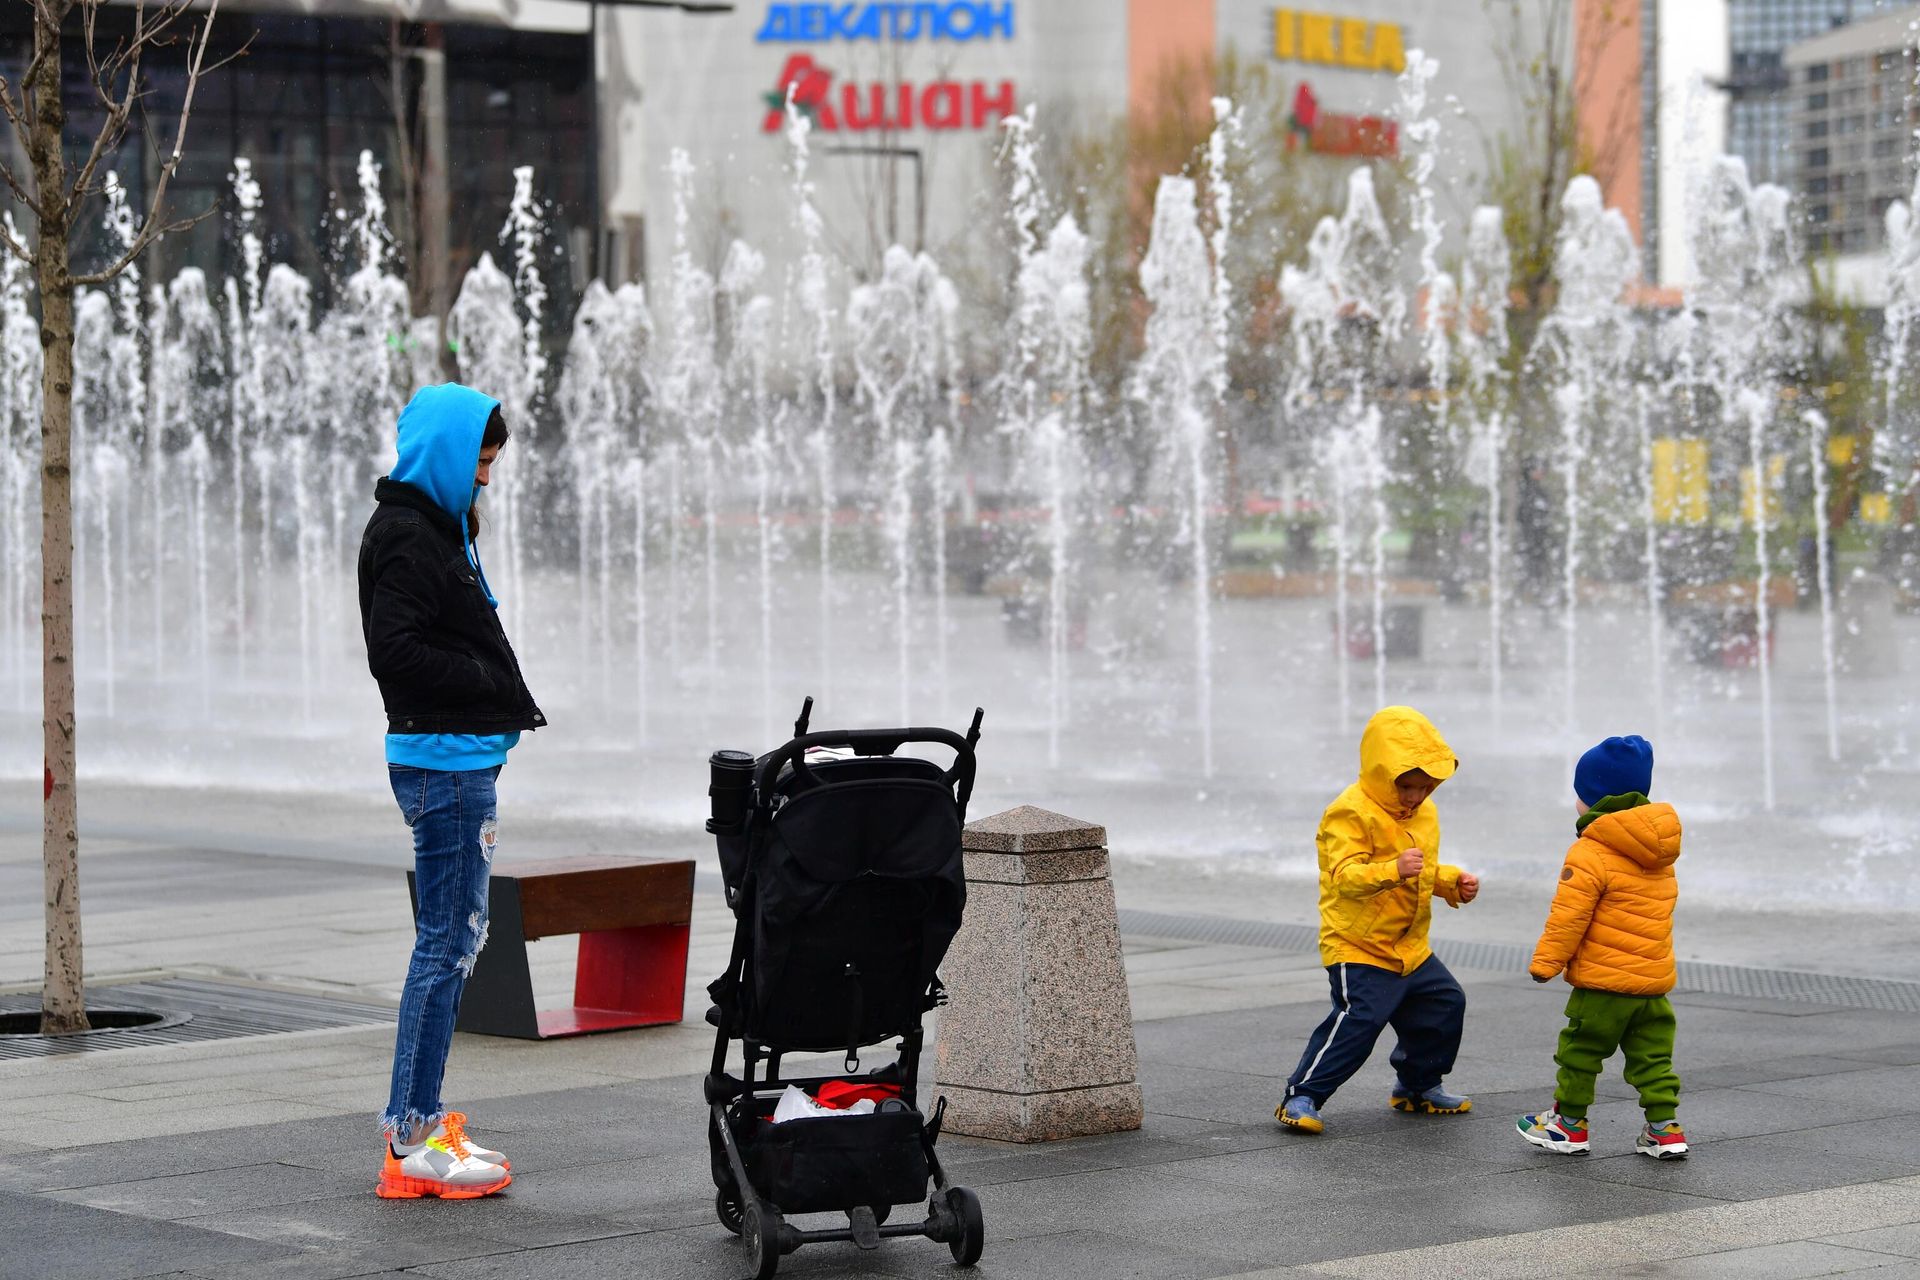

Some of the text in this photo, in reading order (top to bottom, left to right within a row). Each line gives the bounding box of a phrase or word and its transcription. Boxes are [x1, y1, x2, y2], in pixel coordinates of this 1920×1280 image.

[755, 0, 1014, 42] ДЕКАТЛОН
[1273, 8, 1406, 73] IKEA
[761, 53, 1015, 132] Ашан
